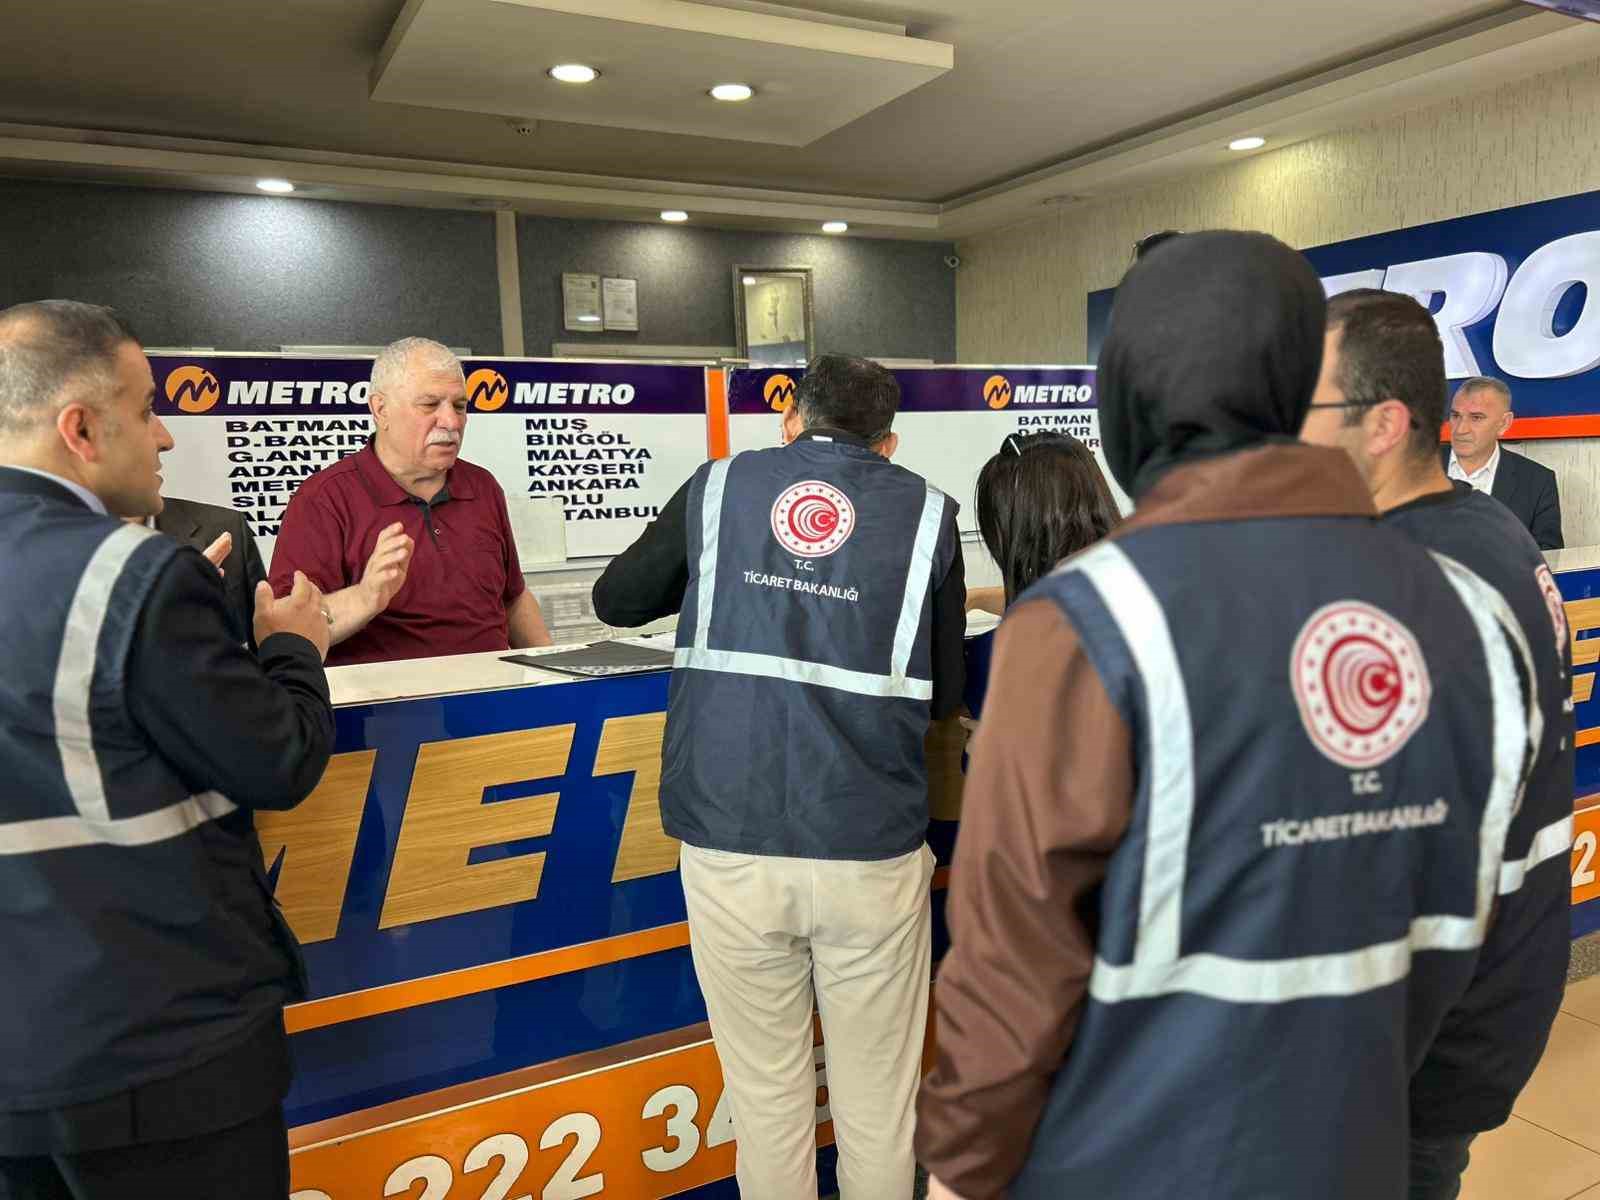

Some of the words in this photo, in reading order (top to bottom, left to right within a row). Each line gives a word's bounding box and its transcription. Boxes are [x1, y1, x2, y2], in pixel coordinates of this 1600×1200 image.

[1320, 230, 1600, 379] RO
[226, 381, 371, 405] METRO
[513, 382, 636, 405] METRO
[1013, 385, 1093, 404] METRO
[225, 419, 369, 433] BATMAN
[525, 418, 588, 432] MUŞ
[1018, 414, 1092, 426] BATMAN
[1018, 426, 1090, 436] DAKIR
[226, 434, 368, 448] D.BAKIR
[526, 431, 631, 446] BİNGÖL
[527, 448, 652, 461] MALATYA
[228, 464, 321, 478] ADAN
[528, 460, 645, 477] KAYSERİ
[231, 479, 304, 493] MER
[527, 478, 640, 492] ANKARA
[232, 493, 287, 508] SİL
[563, 506, 660, 520] TANBUL
[794, 559, 814, 571] T.C.
[743, 570, 793, 590] TİCARET
[793, 580, 859, 602] BAKANLIĞI
